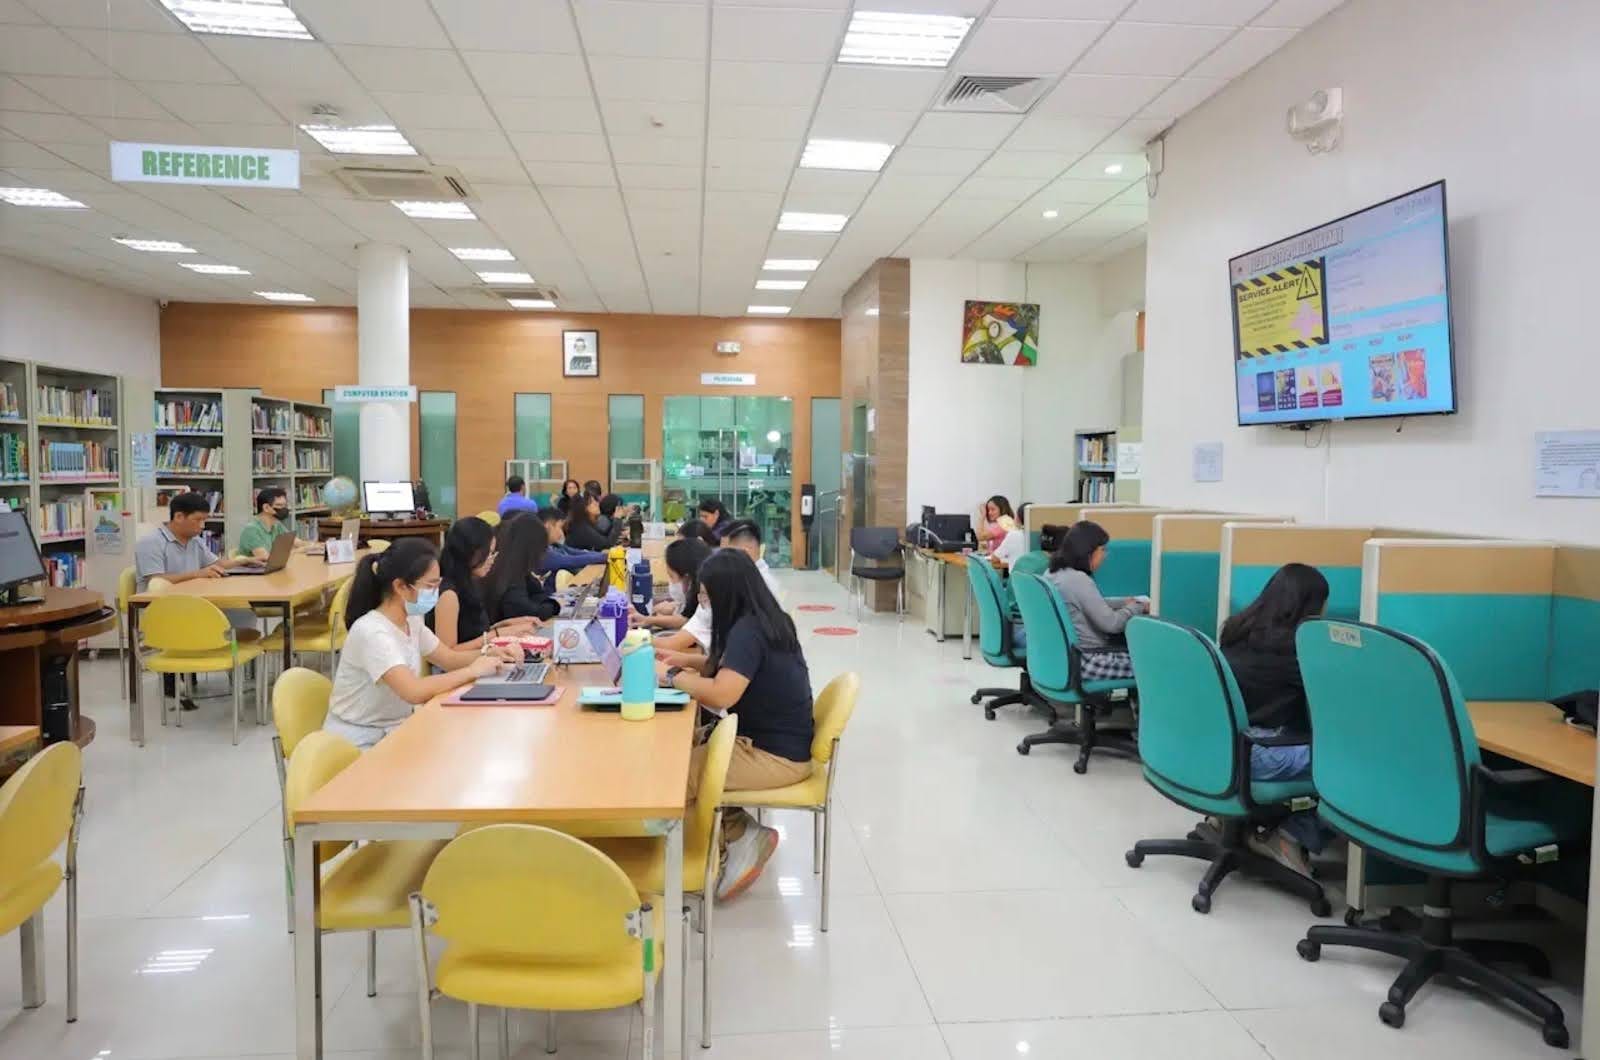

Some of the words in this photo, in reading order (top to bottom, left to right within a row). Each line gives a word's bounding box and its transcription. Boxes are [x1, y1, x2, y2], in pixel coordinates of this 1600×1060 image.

[142, 150, 270, 180] REFERENCE
[1239, 287, 1271, 302] SERVICE
[1272, 279, 1300, 293] ALERT
